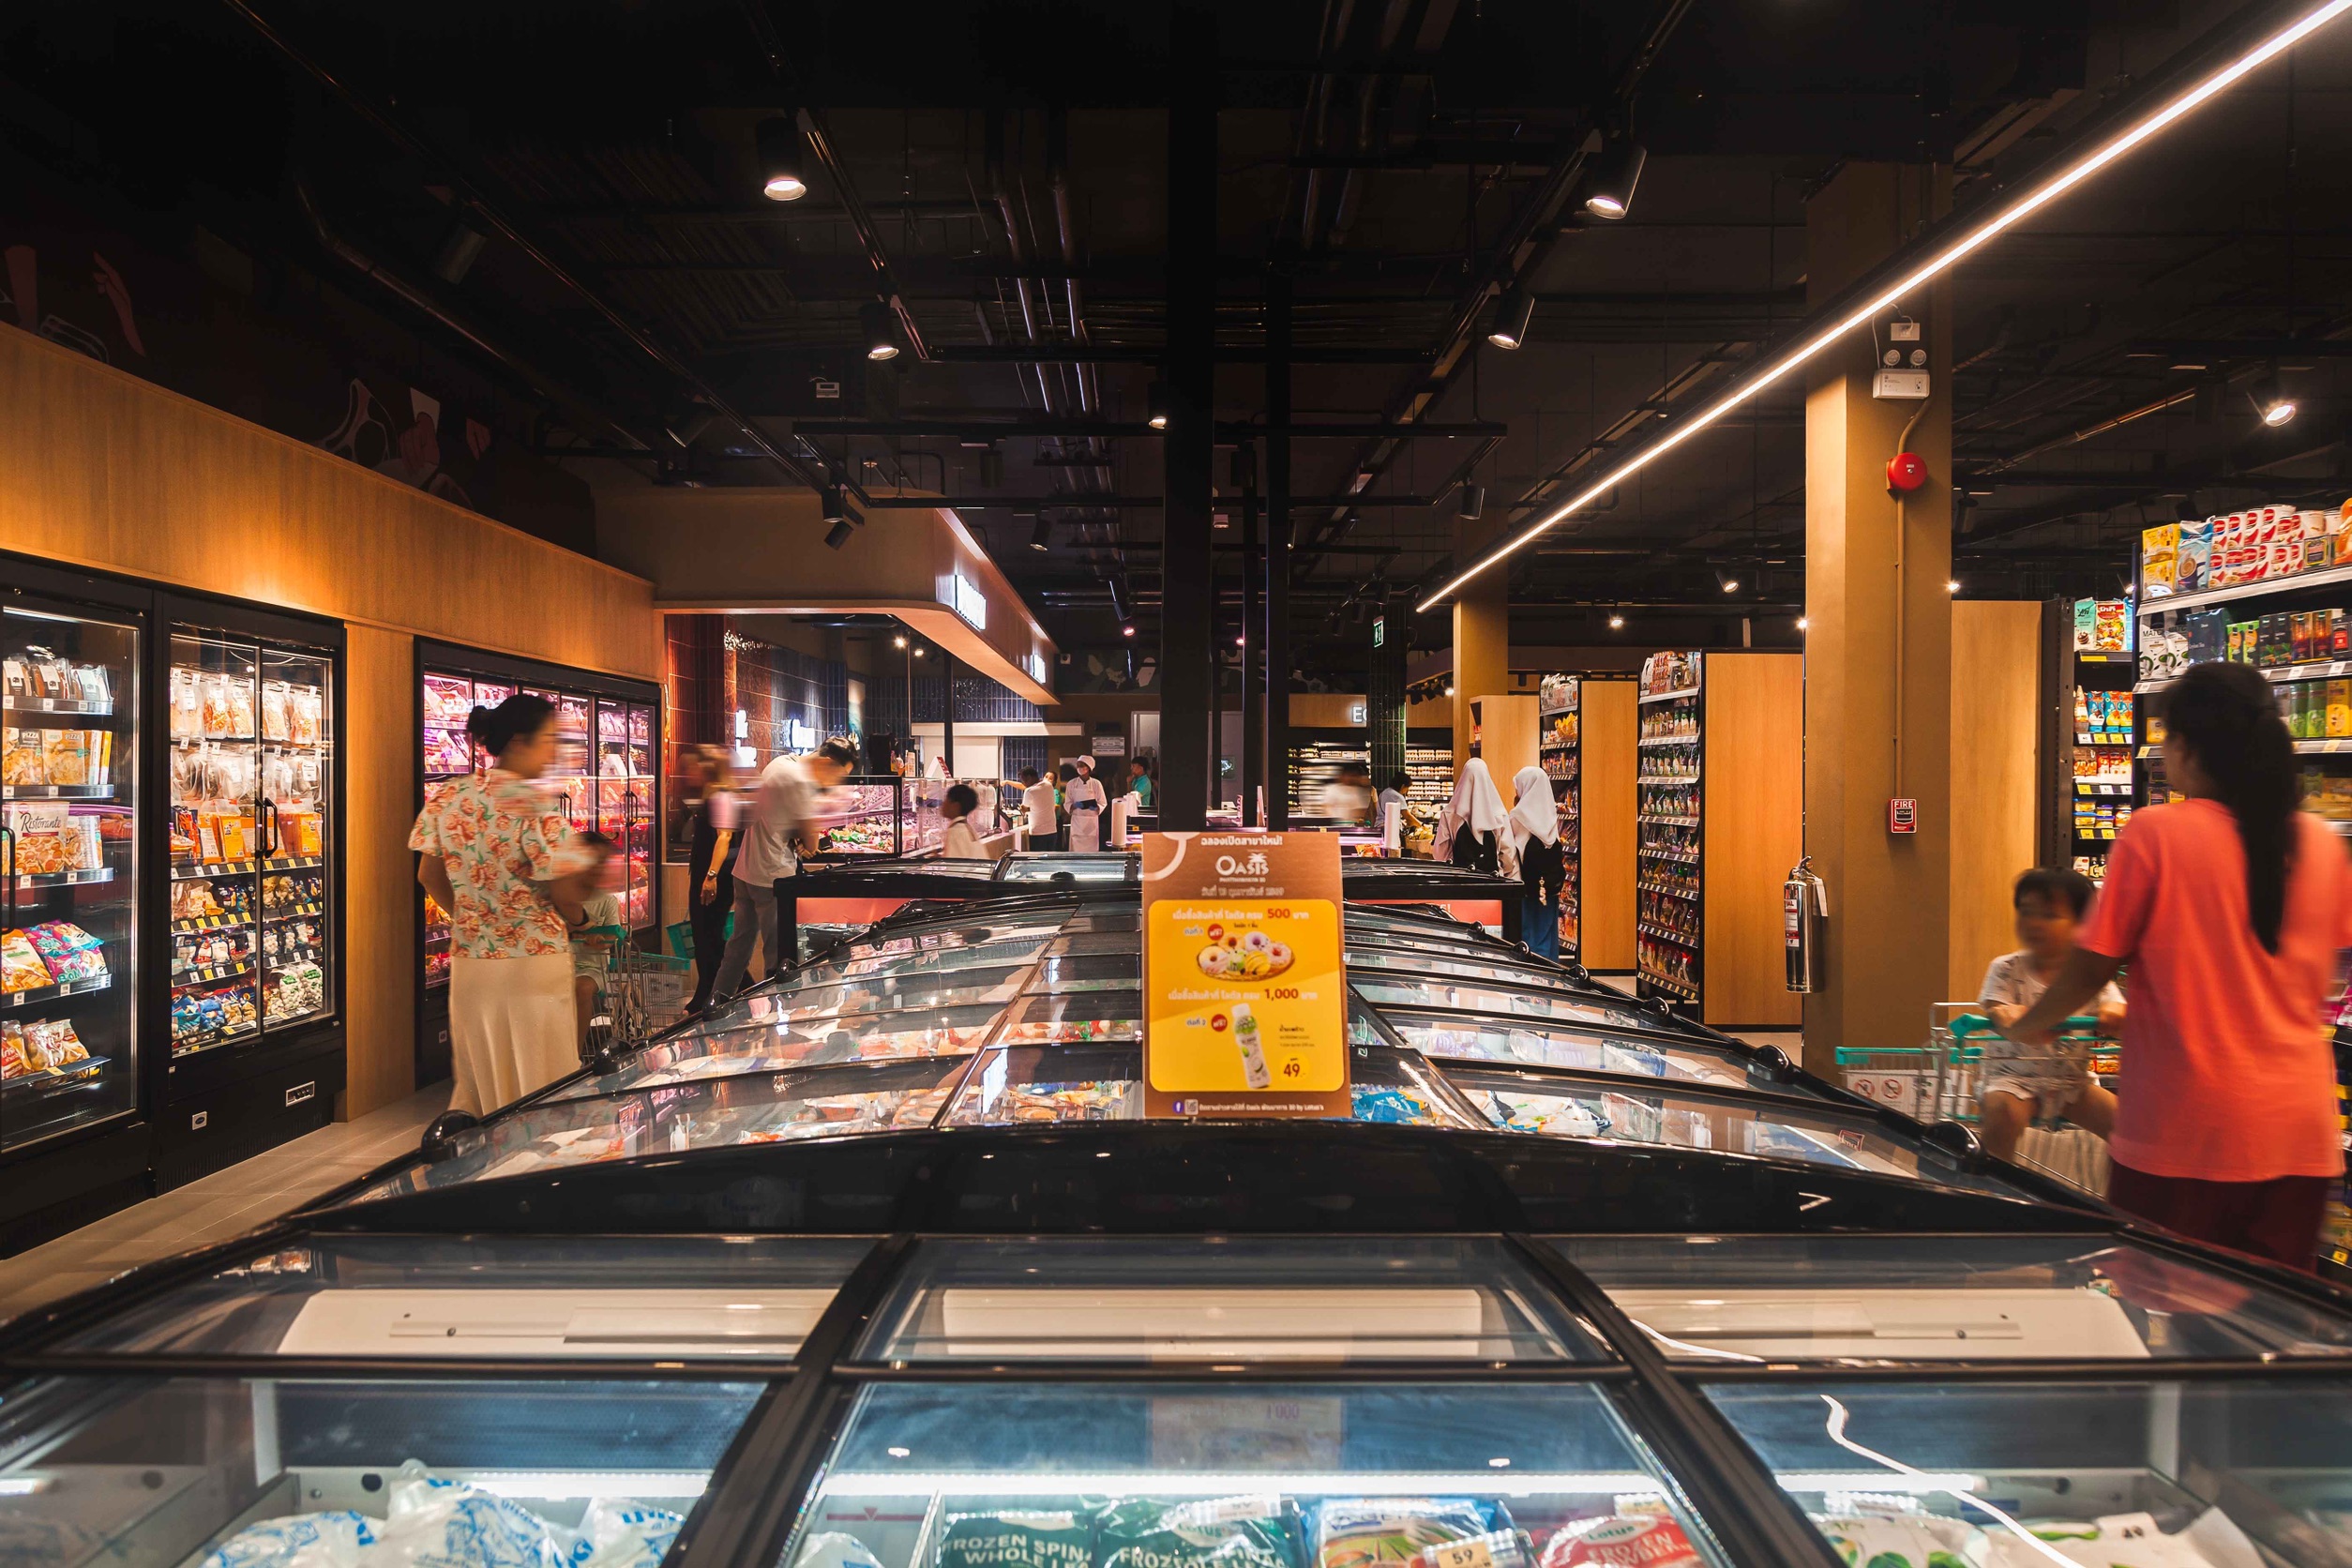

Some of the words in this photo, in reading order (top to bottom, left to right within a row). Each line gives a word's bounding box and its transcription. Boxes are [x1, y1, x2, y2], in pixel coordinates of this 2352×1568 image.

[1894, 800, 1913, 808] FIRE
[20, 813, 62, 833] Ristorante
[1267, 908, 1290, 919] 500
[1264, 988, 1299, 1001] 1,000
[942, 1534, 1027, 1552] FROZEN
[1452, 1548, 1473, 1565] 59
